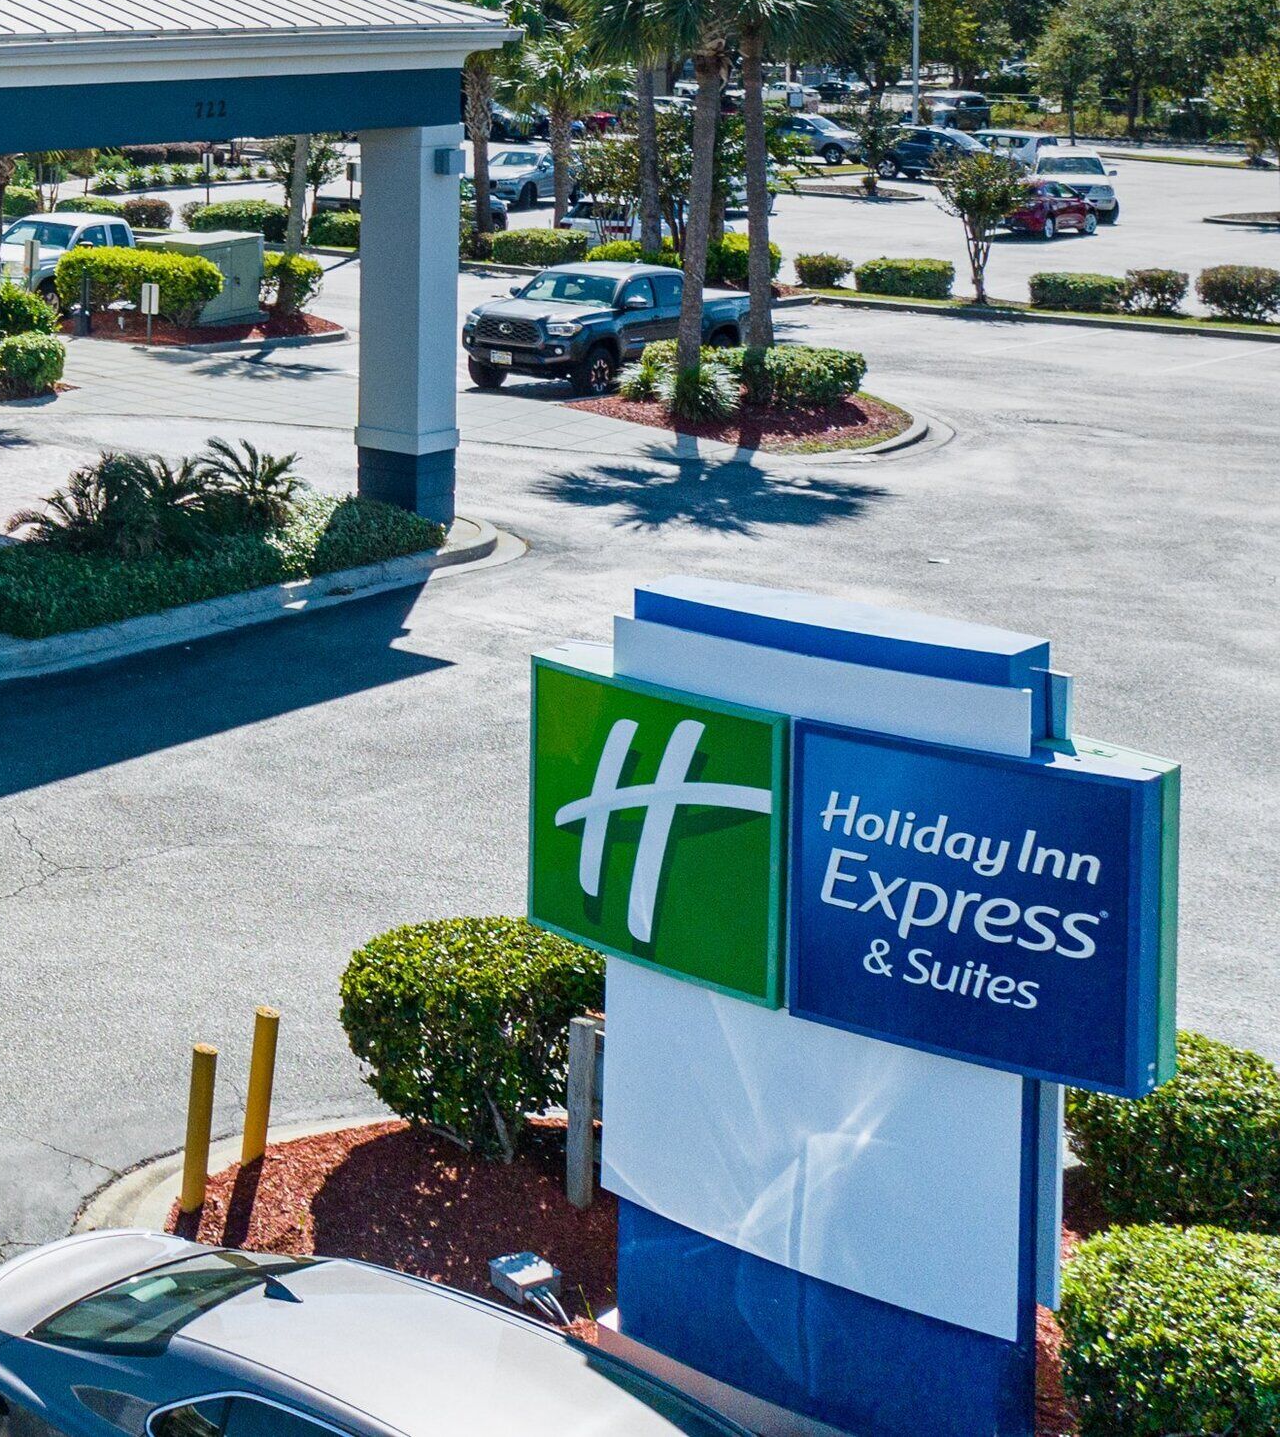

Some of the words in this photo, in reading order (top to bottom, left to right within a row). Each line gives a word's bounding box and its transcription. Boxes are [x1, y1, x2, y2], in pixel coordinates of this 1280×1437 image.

[195, 99, 226, 119] 722
[820, 791, 1010, 877] Holiday
[1017, 829, 1101, 885] Inn
[820, 847, 1100, 959] Express
[863, 938, 893, 978] &
[903, 948, 1040, 1009] Suites
